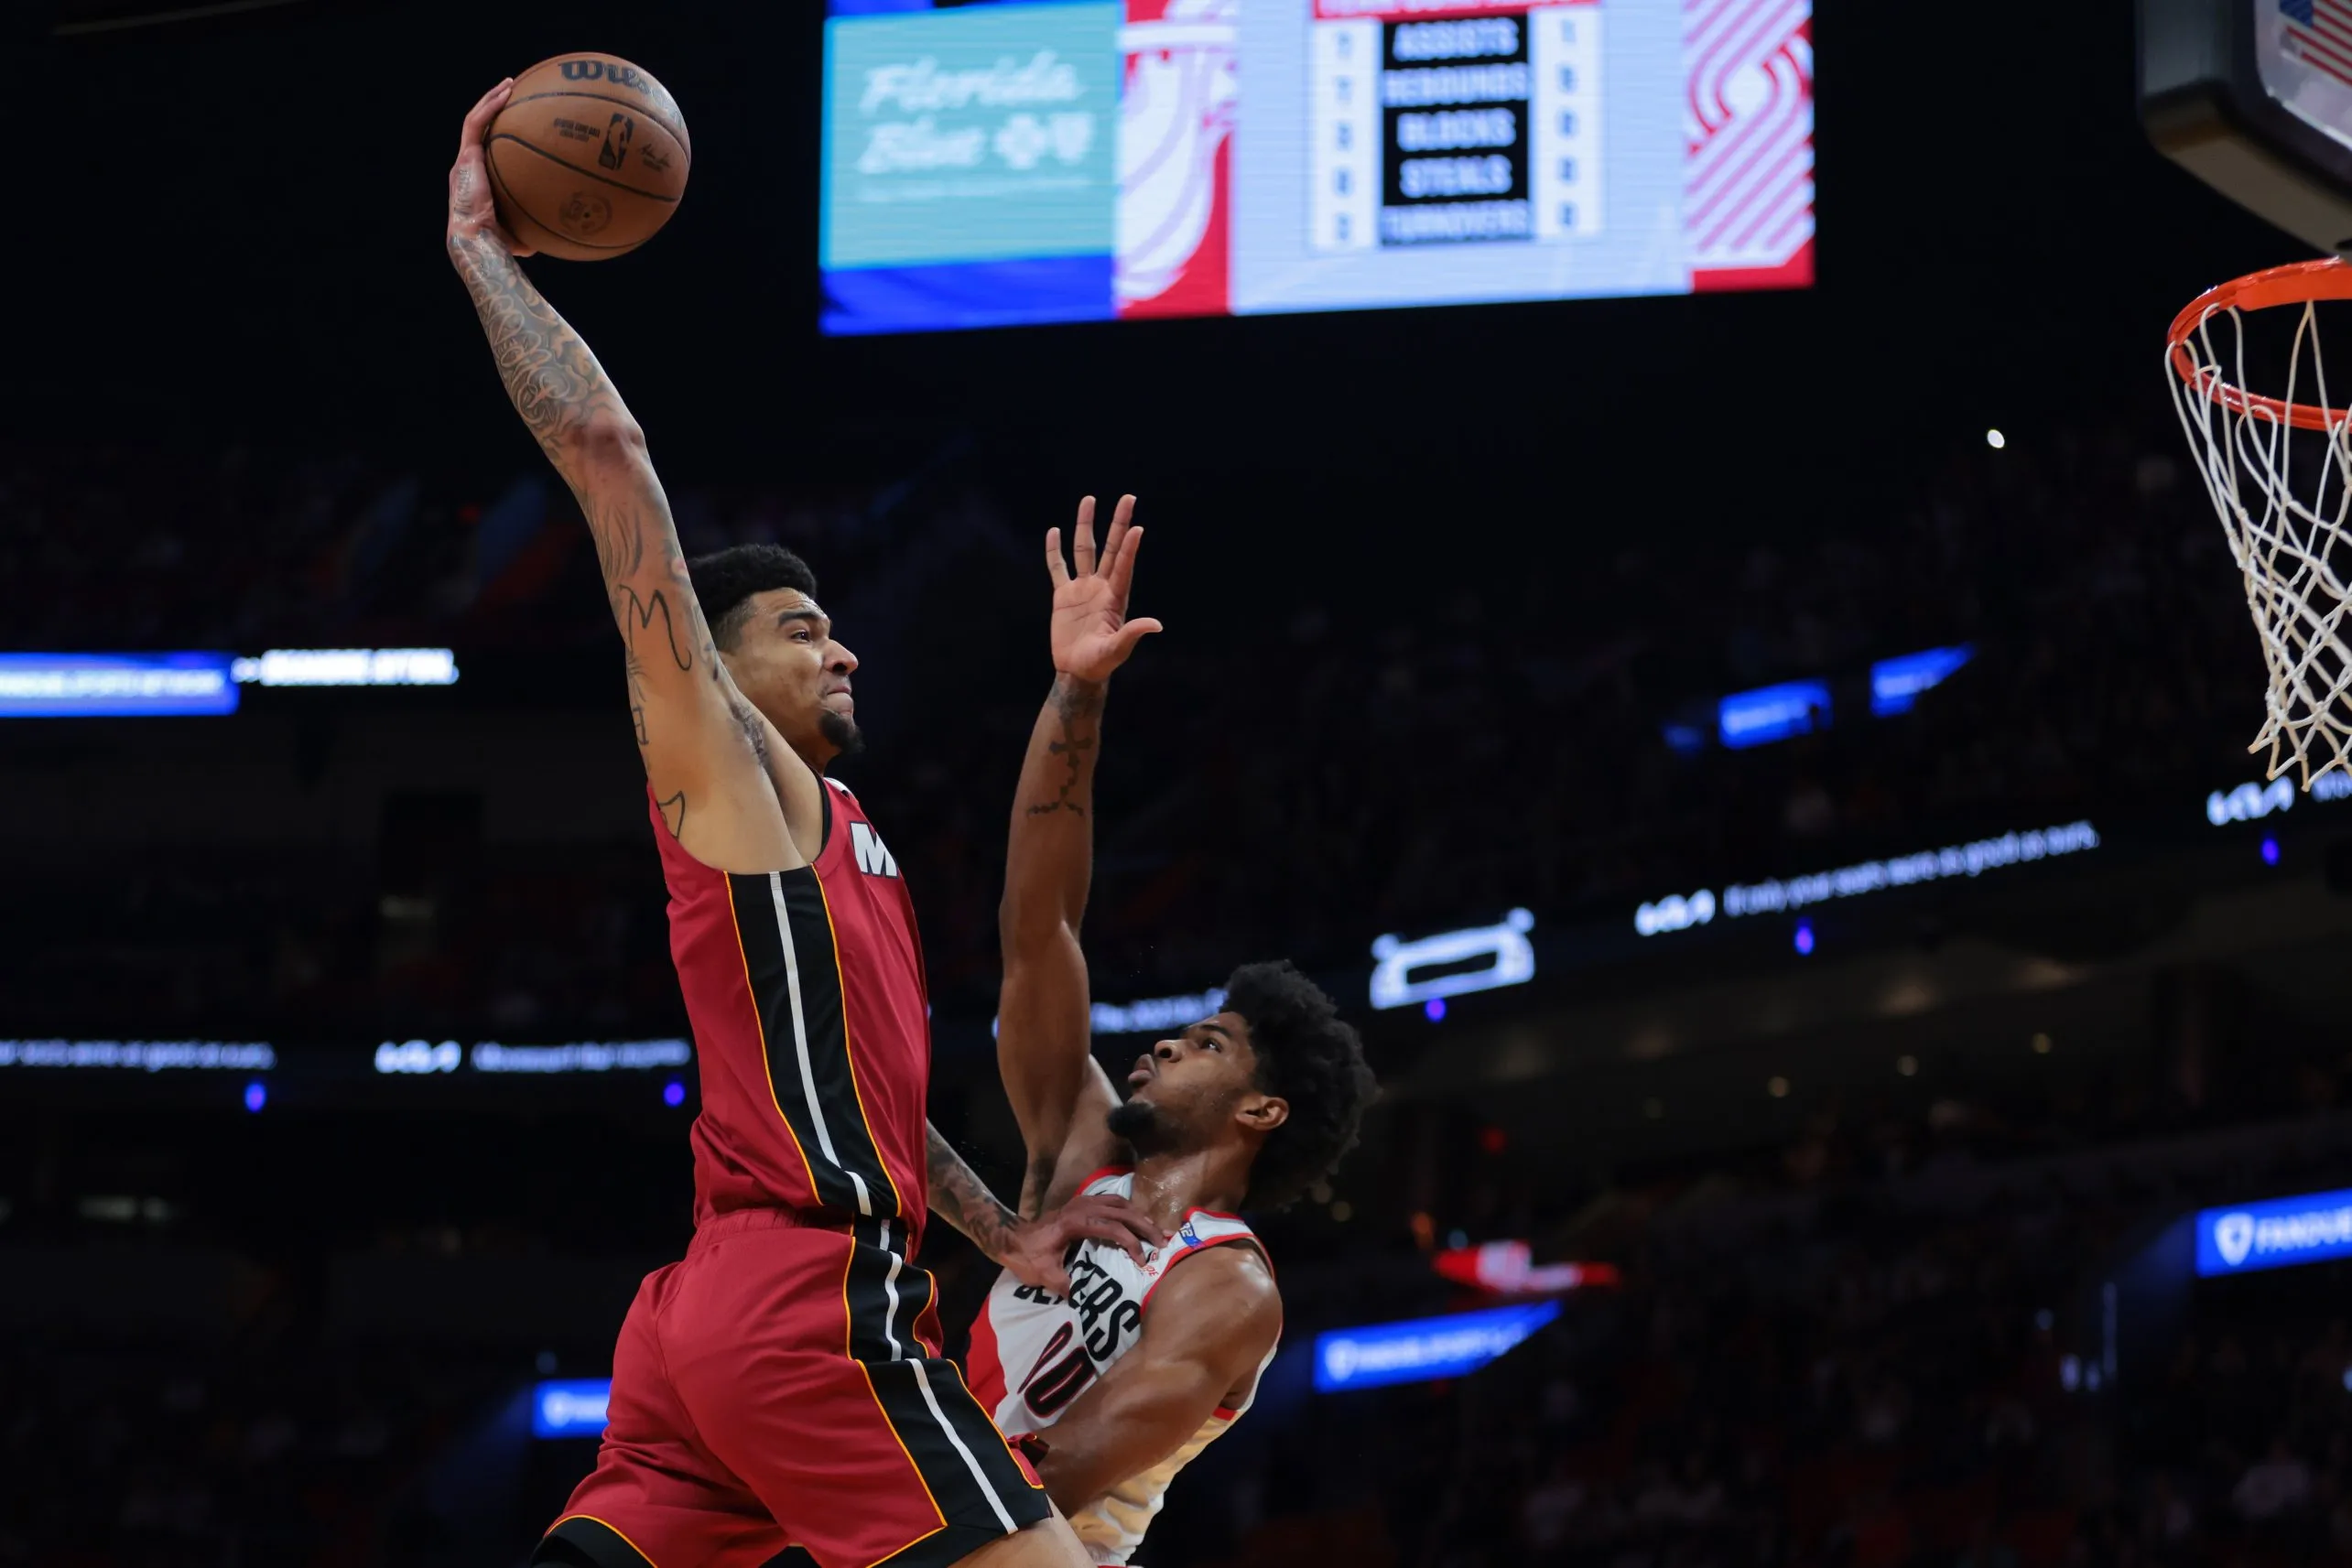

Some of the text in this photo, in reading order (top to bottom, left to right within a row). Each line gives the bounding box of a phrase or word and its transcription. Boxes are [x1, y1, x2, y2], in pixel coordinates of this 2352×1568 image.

[1393, 18, 1519, 60] ASSISTS
[859, 49, 1080, 113] Florida
[1383, 63, 1530, 106] REBOUNDS
[857, 115, 986, 174] Blue
[1397, 108, 1517, 152] BLOCKS
[1399, 155, 1513, 198] STEALS
